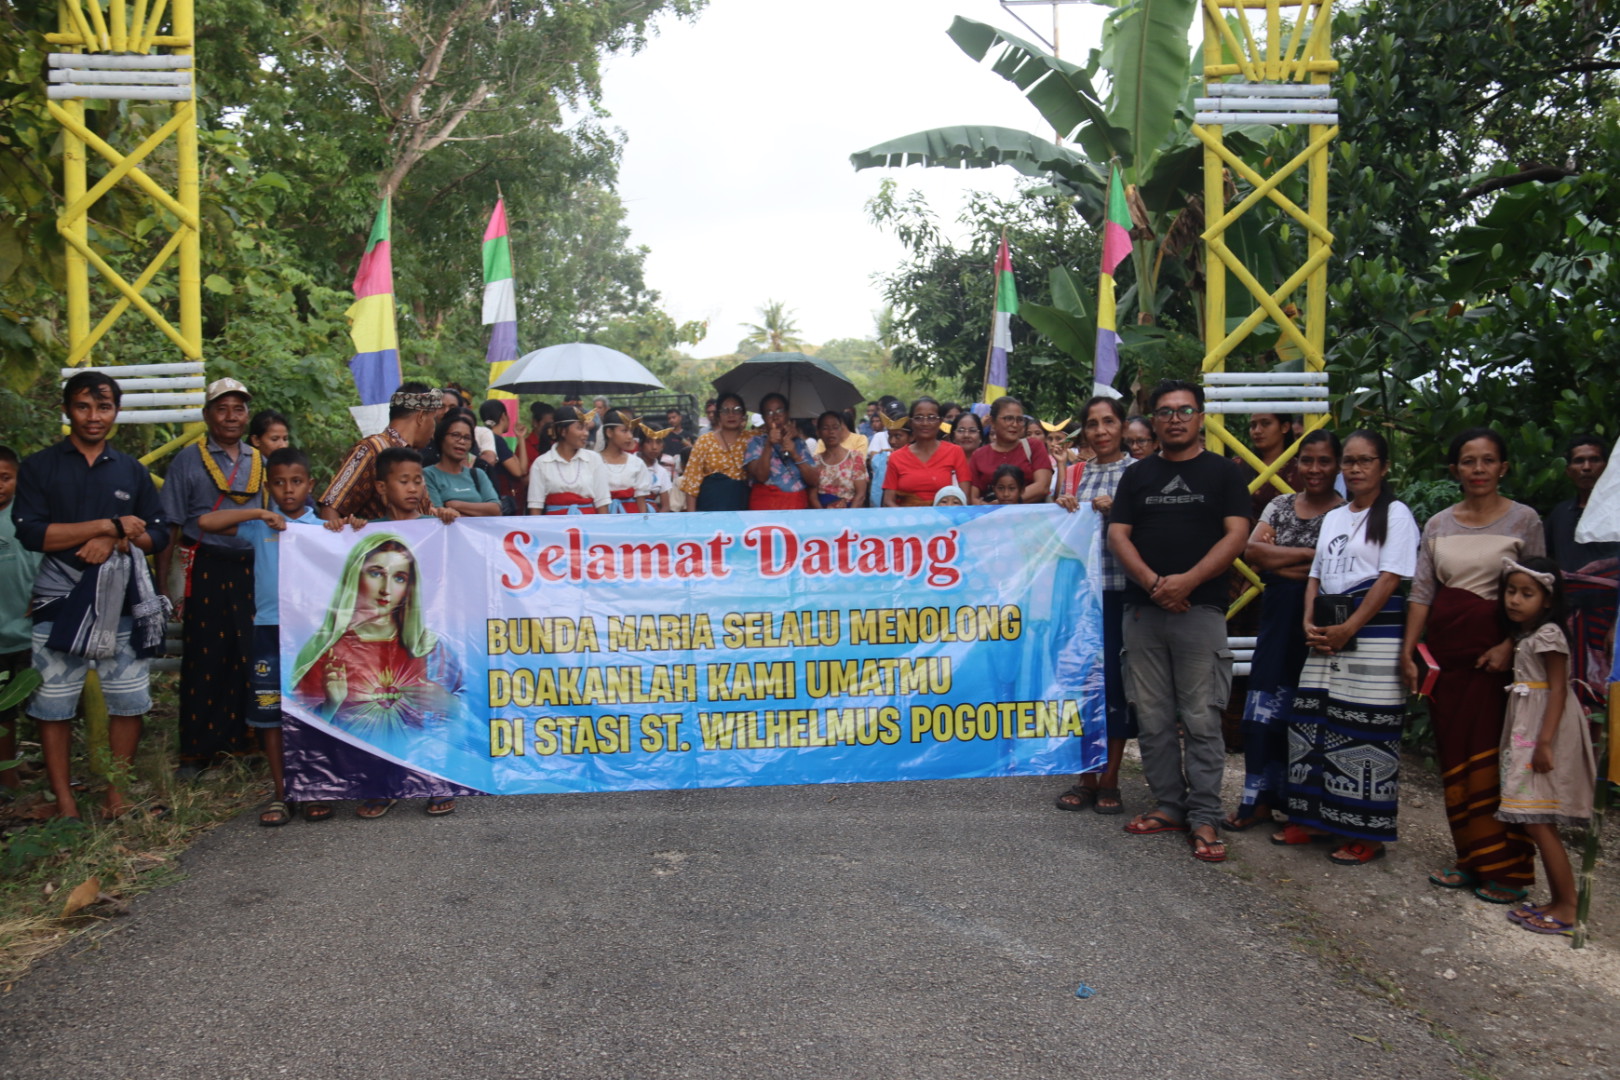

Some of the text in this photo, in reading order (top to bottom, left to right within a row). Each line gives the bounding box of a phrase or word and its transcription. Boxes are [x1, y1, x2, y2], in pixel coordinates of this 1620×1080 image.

[501, 525, 961, 591] Selamat Datang
[487, 604, 1022, 655] BUNDA MARIA SELALU MENOLONG
[488, 656, 953, 708] DOAKANLAH KAMI UMATMU
[489, 699, 1084, 757] DI STASI ST. WILHELMUS POGOTENA
